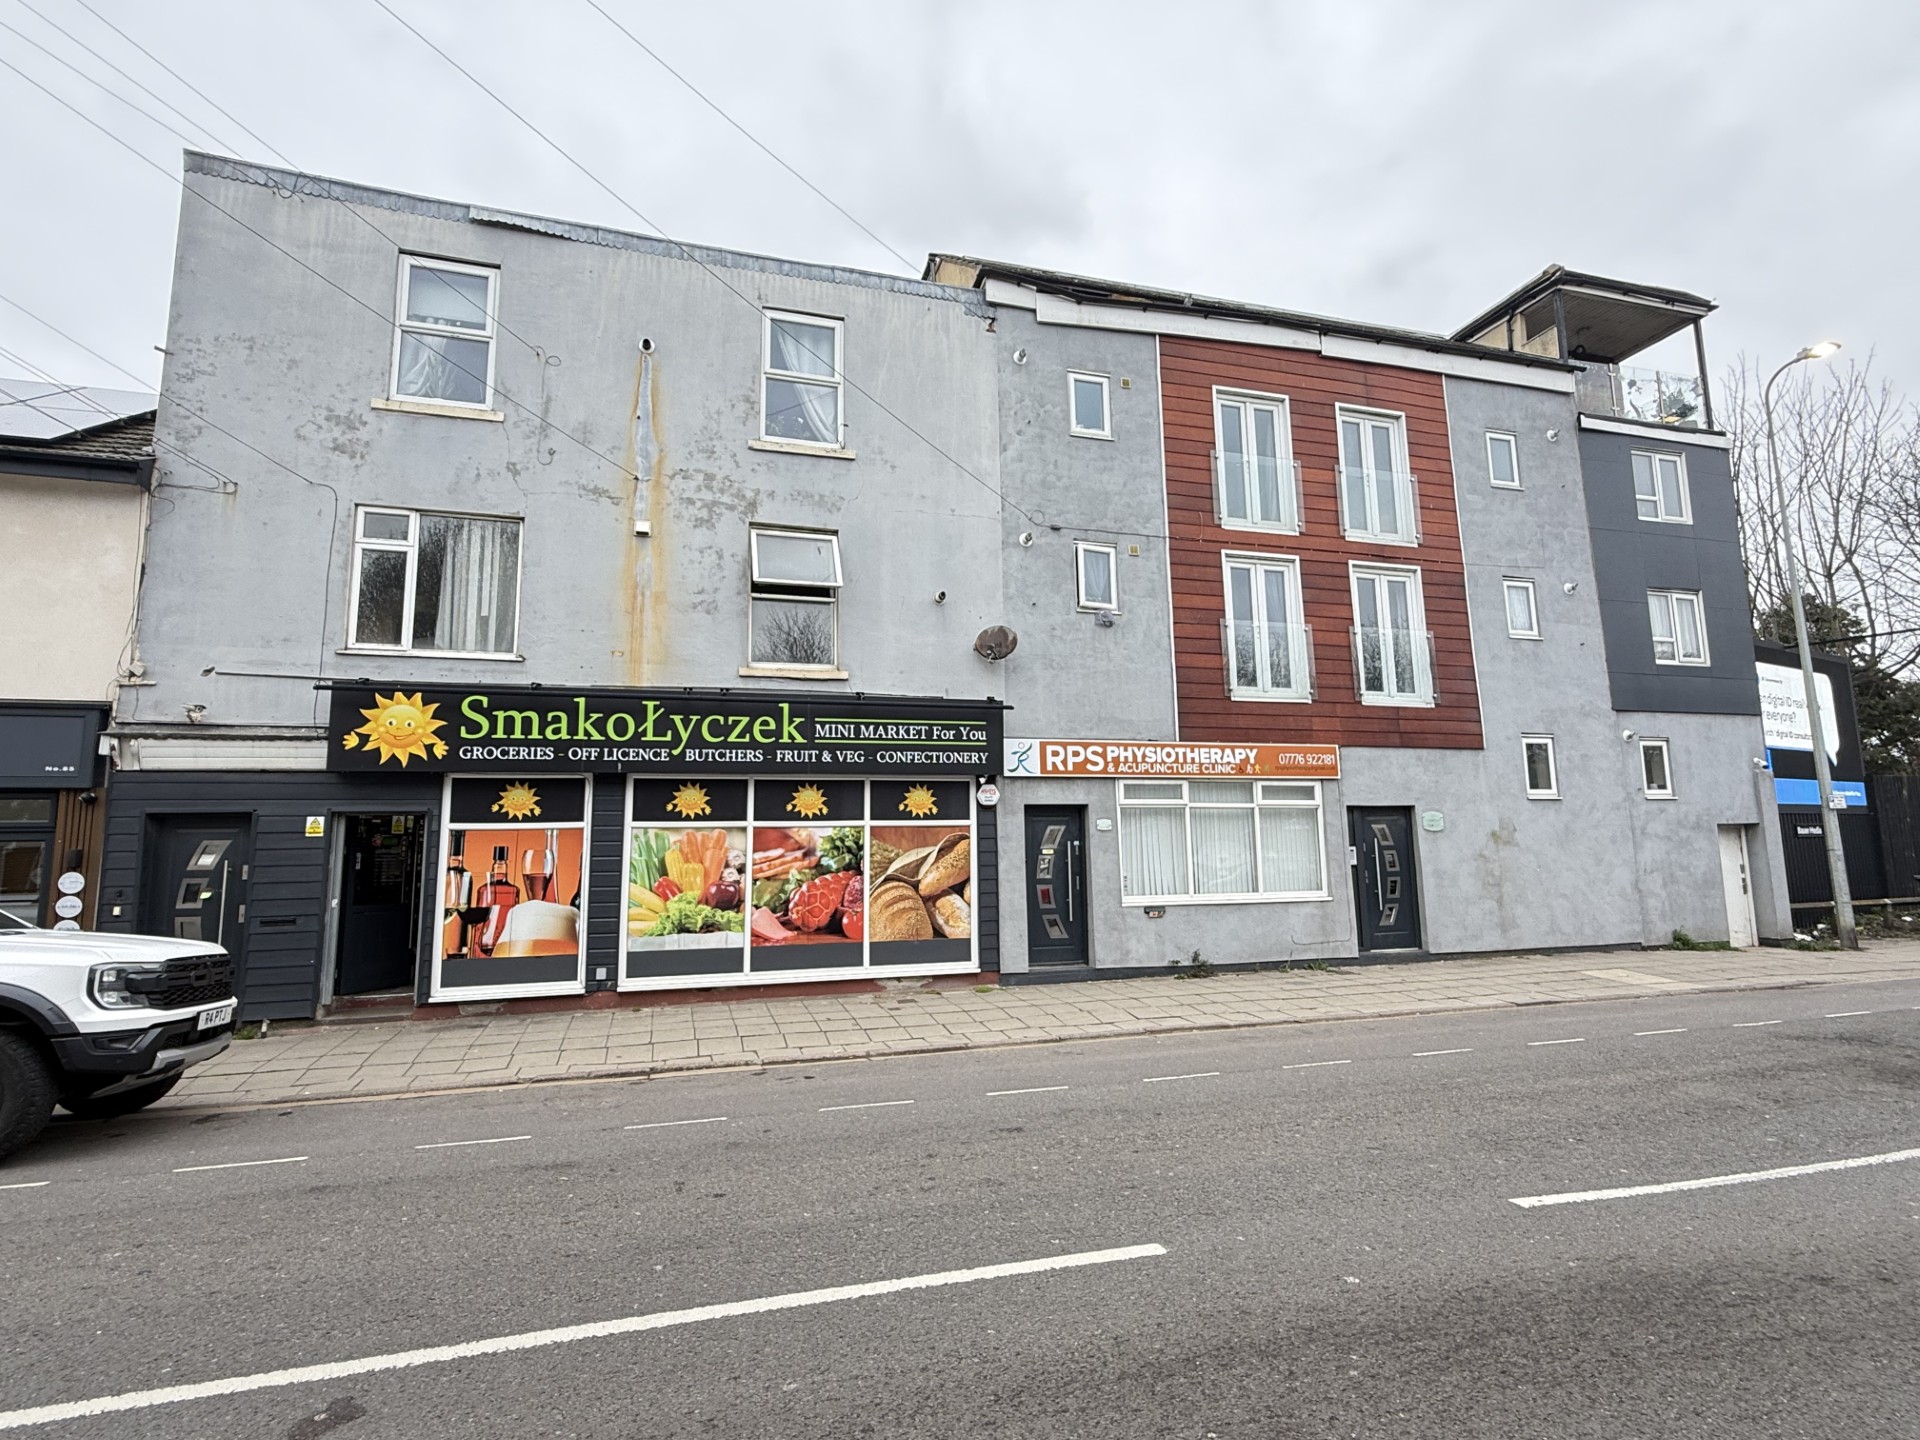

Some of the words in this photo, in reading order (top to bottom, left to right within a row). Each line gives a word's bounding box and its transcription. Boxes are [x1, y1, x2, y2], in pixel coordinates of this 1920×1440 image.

[459, 694, 808, 756] SmakoŁyczek
[815, 724, 855, 738] MINI
[859, 725, 928, 739] MARKET
[932, 726, 956, 740] For
[959, 727, 987, 741] You
[459, 746, 554, 760] GROCERIES
[568, 747, 600, 761] OFF
[603, 748, 670, 762] LICENCE
[685, 749, 763, 762] BUTCHERS
[776, 750, 818, 763] FRUIT
[821, 750, 833, 763] &
[836, 750, 865, 763] VEG
[876, 751, 989, 764] CONFECTIONERY
[1046, 744, 1105, 772] RPS
[1106, 745, 1258, 764] PHYSIOTHERAPY
[1278, 753, 1305, 765] 07776
[1306, 754, 1335, 766] 922181
[1107, 762, 1116, 773] &
[1117, 763, 1200, 774] ACUPUNCTURE
[1202, 763, 1236, 775] CLINIC
